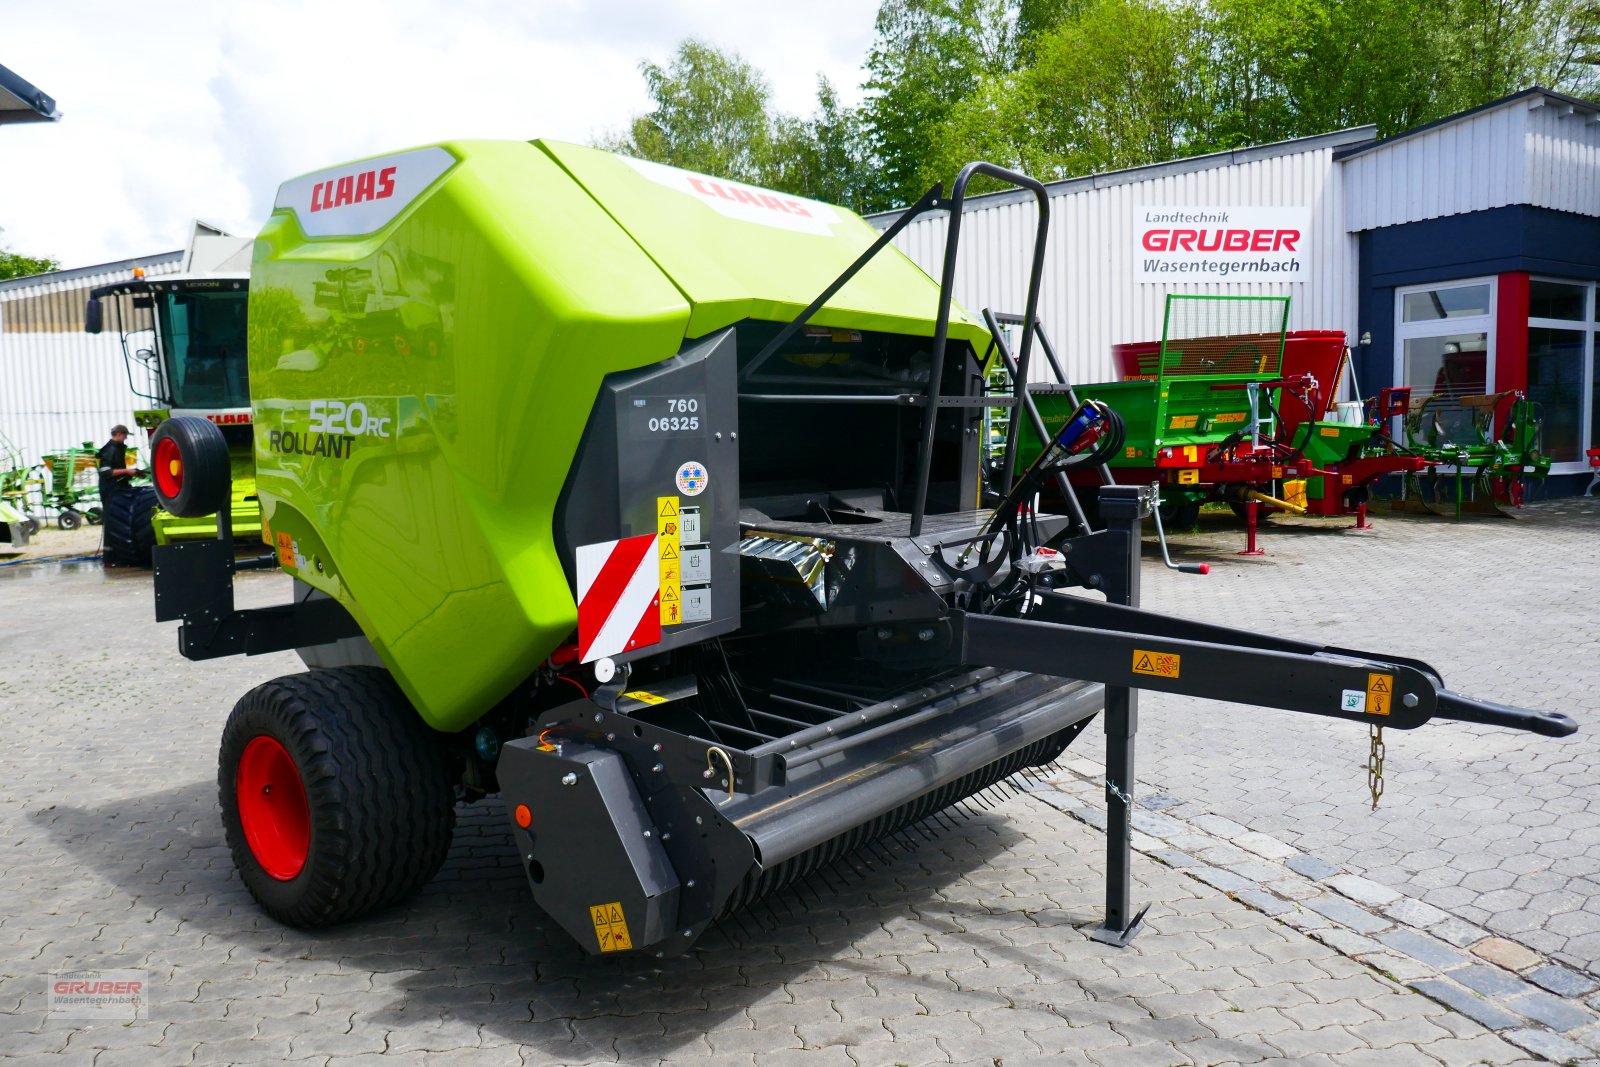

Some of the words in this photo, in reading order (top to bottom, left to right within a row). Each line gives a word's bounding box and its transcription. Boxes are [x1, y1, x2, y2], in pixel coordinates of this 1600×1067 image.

[310, 166, 397, 213] CLAAS
[686, 177, 813, 218] CLAAS
[1145, 211, 1230, 223] Landtechnik
[1142, 229, 1301, 252] GRUBER
[1143, 257, 1300, 276] Wasentegernbach
[667, 398, 698, 413] 760
[648, 416, 699, 432] 06325
[269, 429, 356, 460] ROLLANT
